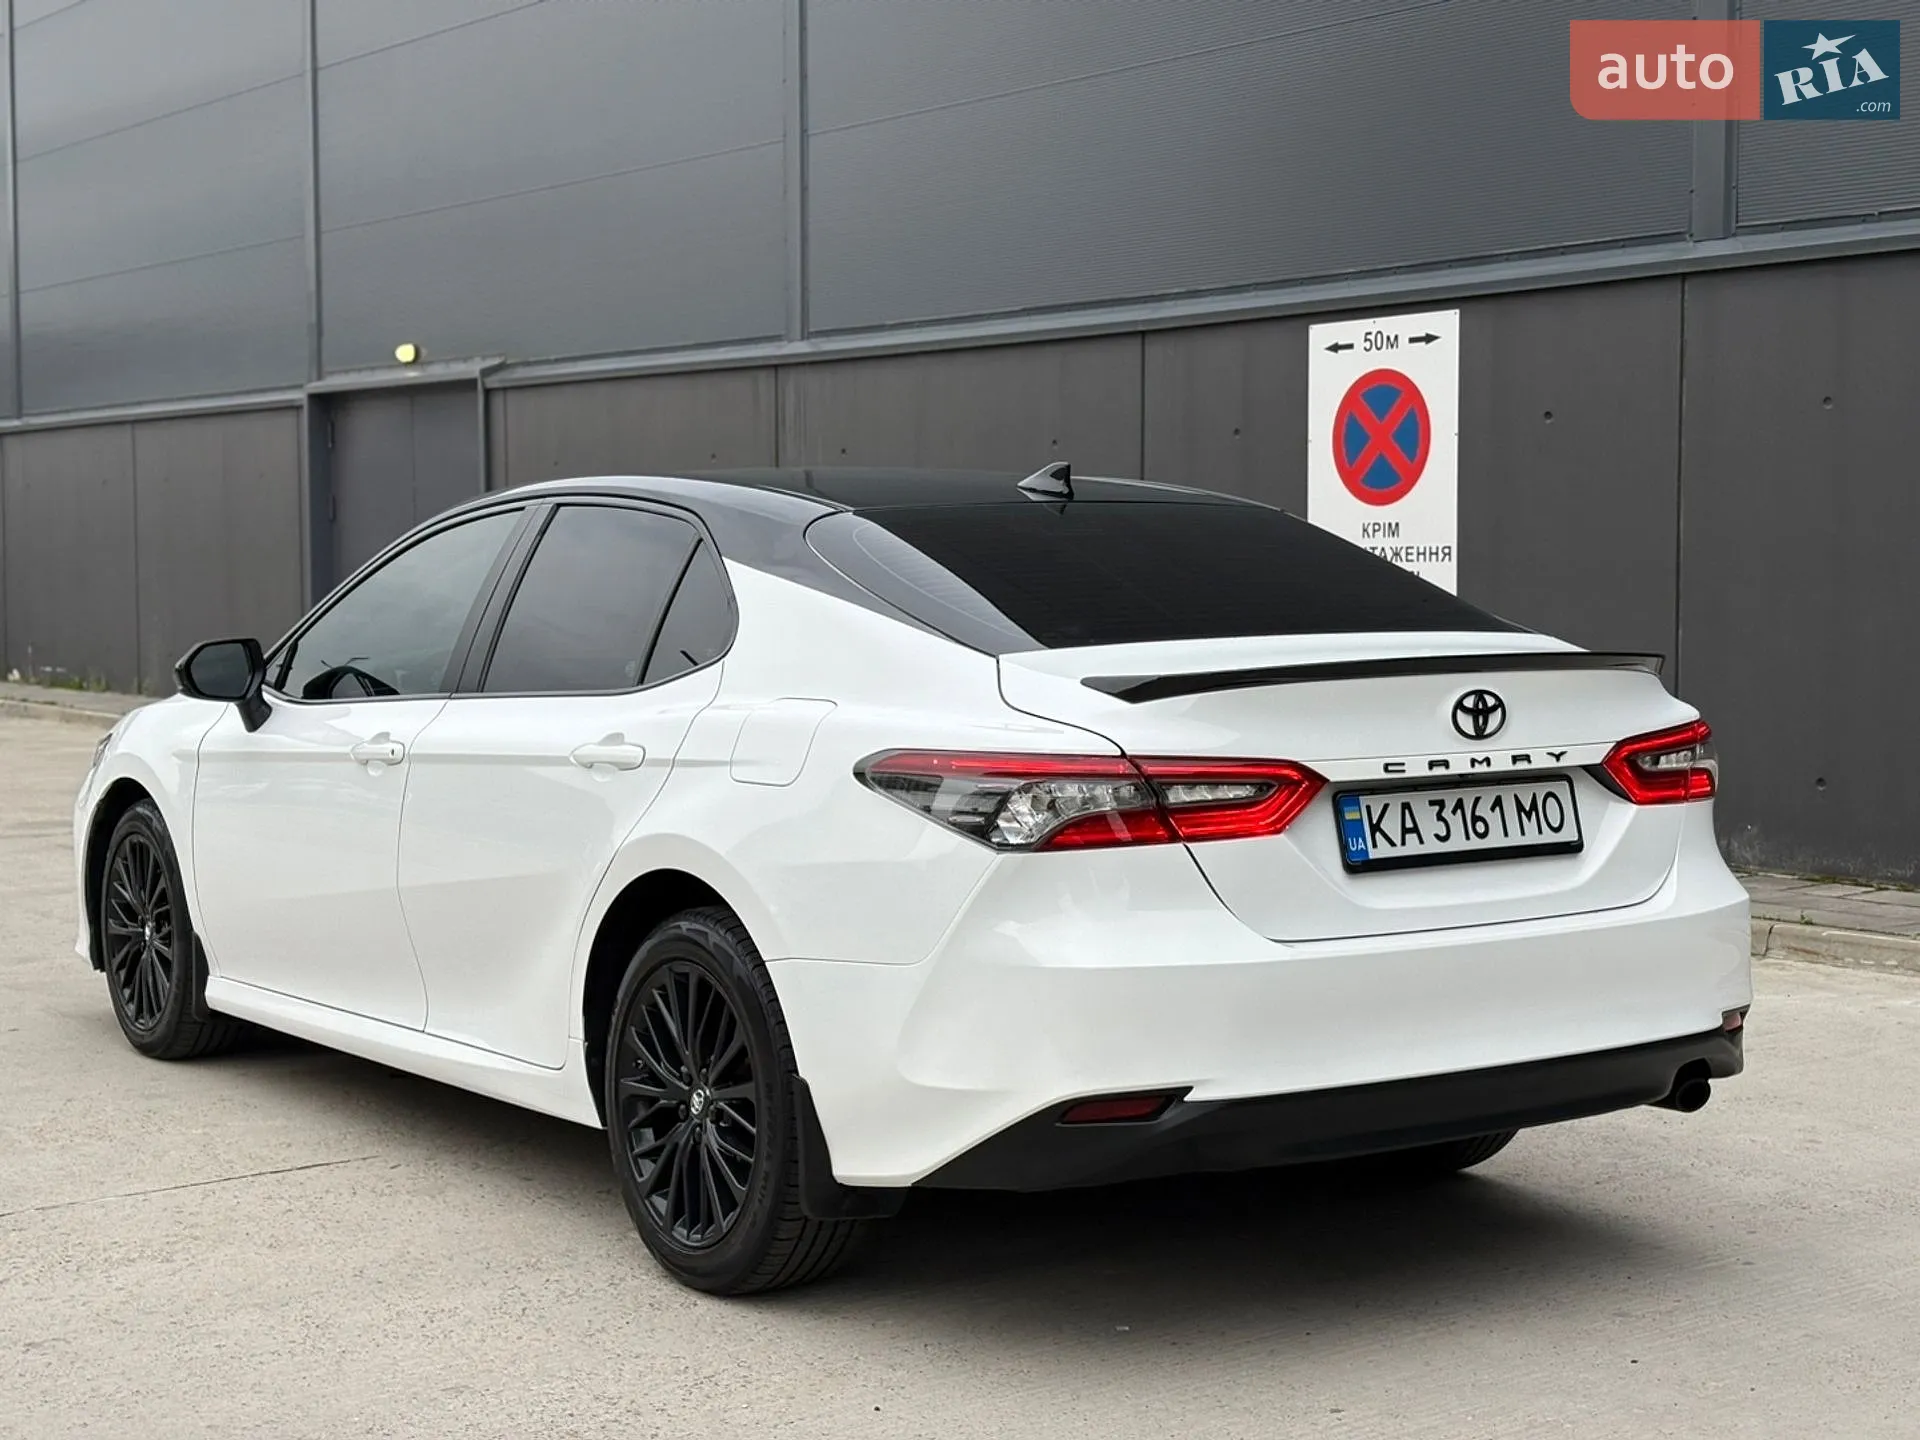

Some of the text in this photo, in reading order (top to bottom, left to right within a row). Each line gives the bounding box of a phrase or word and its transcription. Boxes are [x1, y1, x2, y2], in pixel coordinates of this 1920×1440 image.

[1362, 521, 1400, 539] КРІМ
[1383, 750, 1568, 774] CAMRY
[1365, 791, 1565, 849] KA 3161 MO
[1348, 838, 1366, 851] UA
